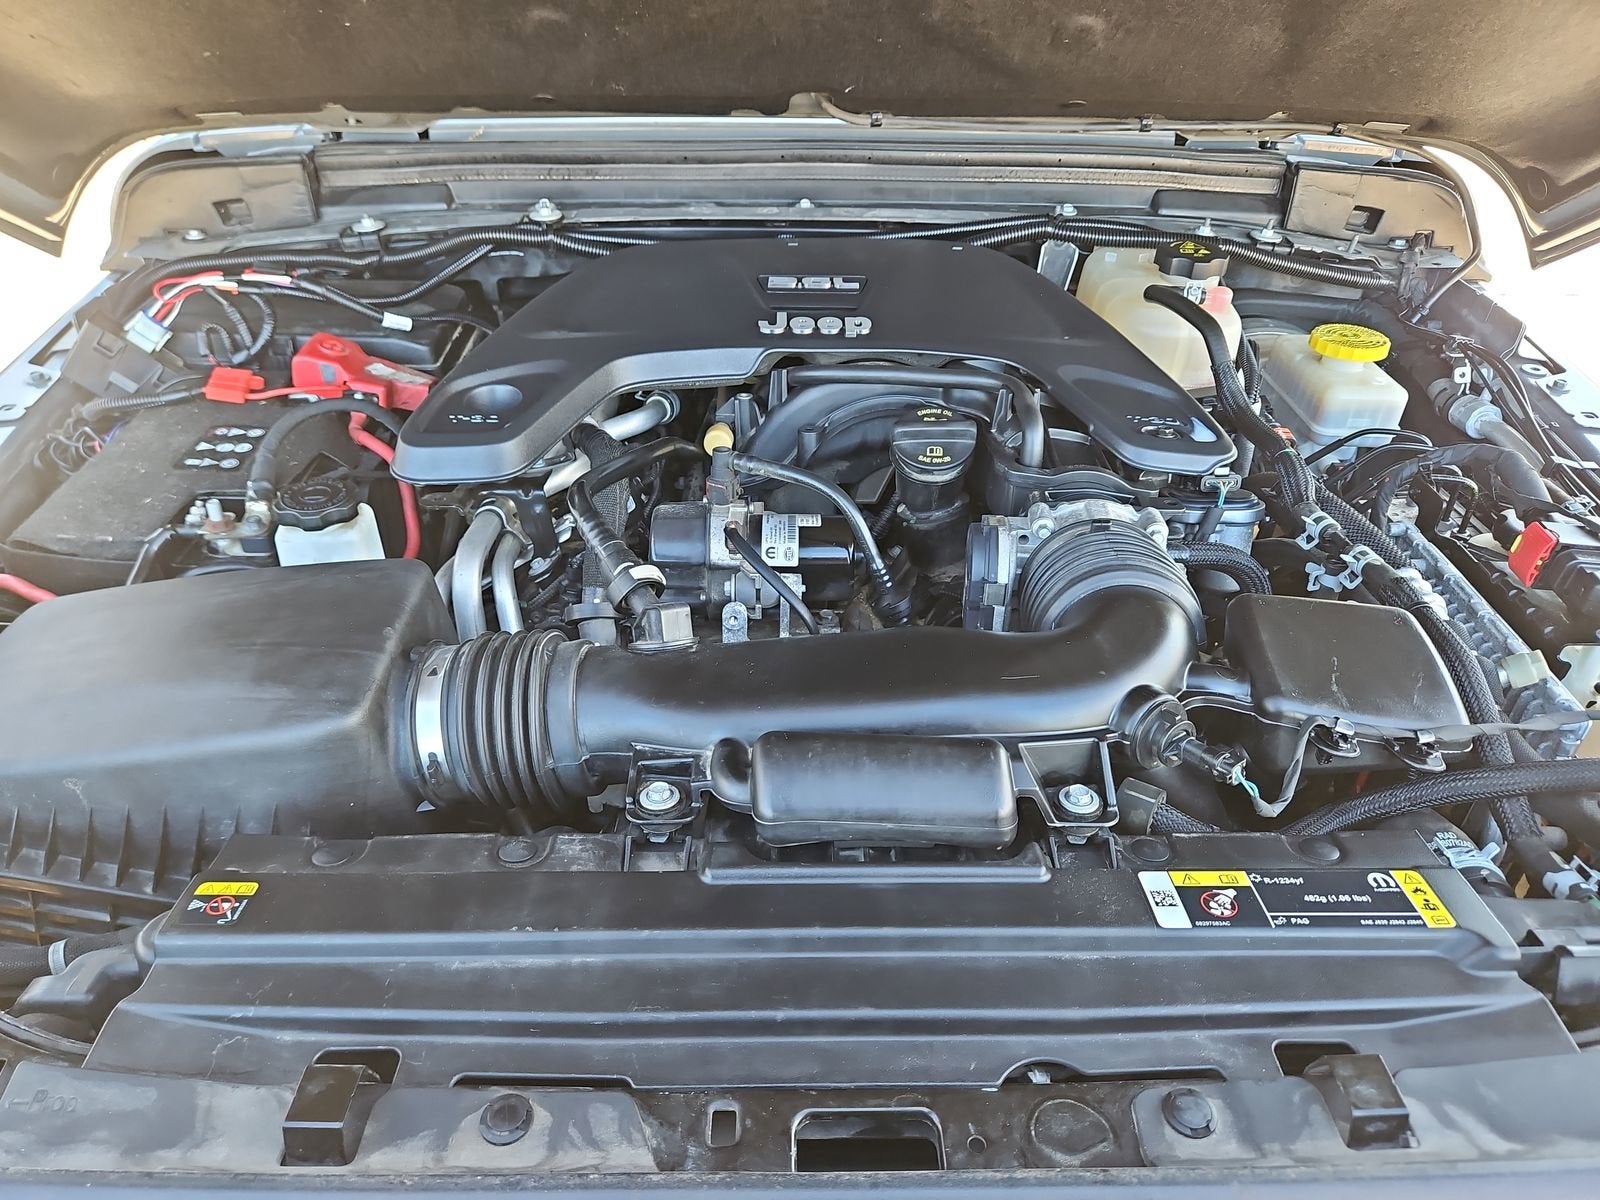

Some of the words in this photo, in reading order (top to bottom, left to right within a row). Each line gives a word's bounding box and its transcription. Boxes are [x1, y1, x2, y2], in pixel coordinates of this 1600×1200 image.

[758, 312, 872, 337] Jeep
[916, 408, 942, 417] ENGINE
[942, 409, 953, 417] OIL
[917, 454, 932, 463] SAE
[1436, 831, 1458, 841] RAD
[1263, 877, 1304, 886] R-1234yf
[1351, 894, 1372, 904] lbs)
[1291, 917, 1310, 925] PAG
